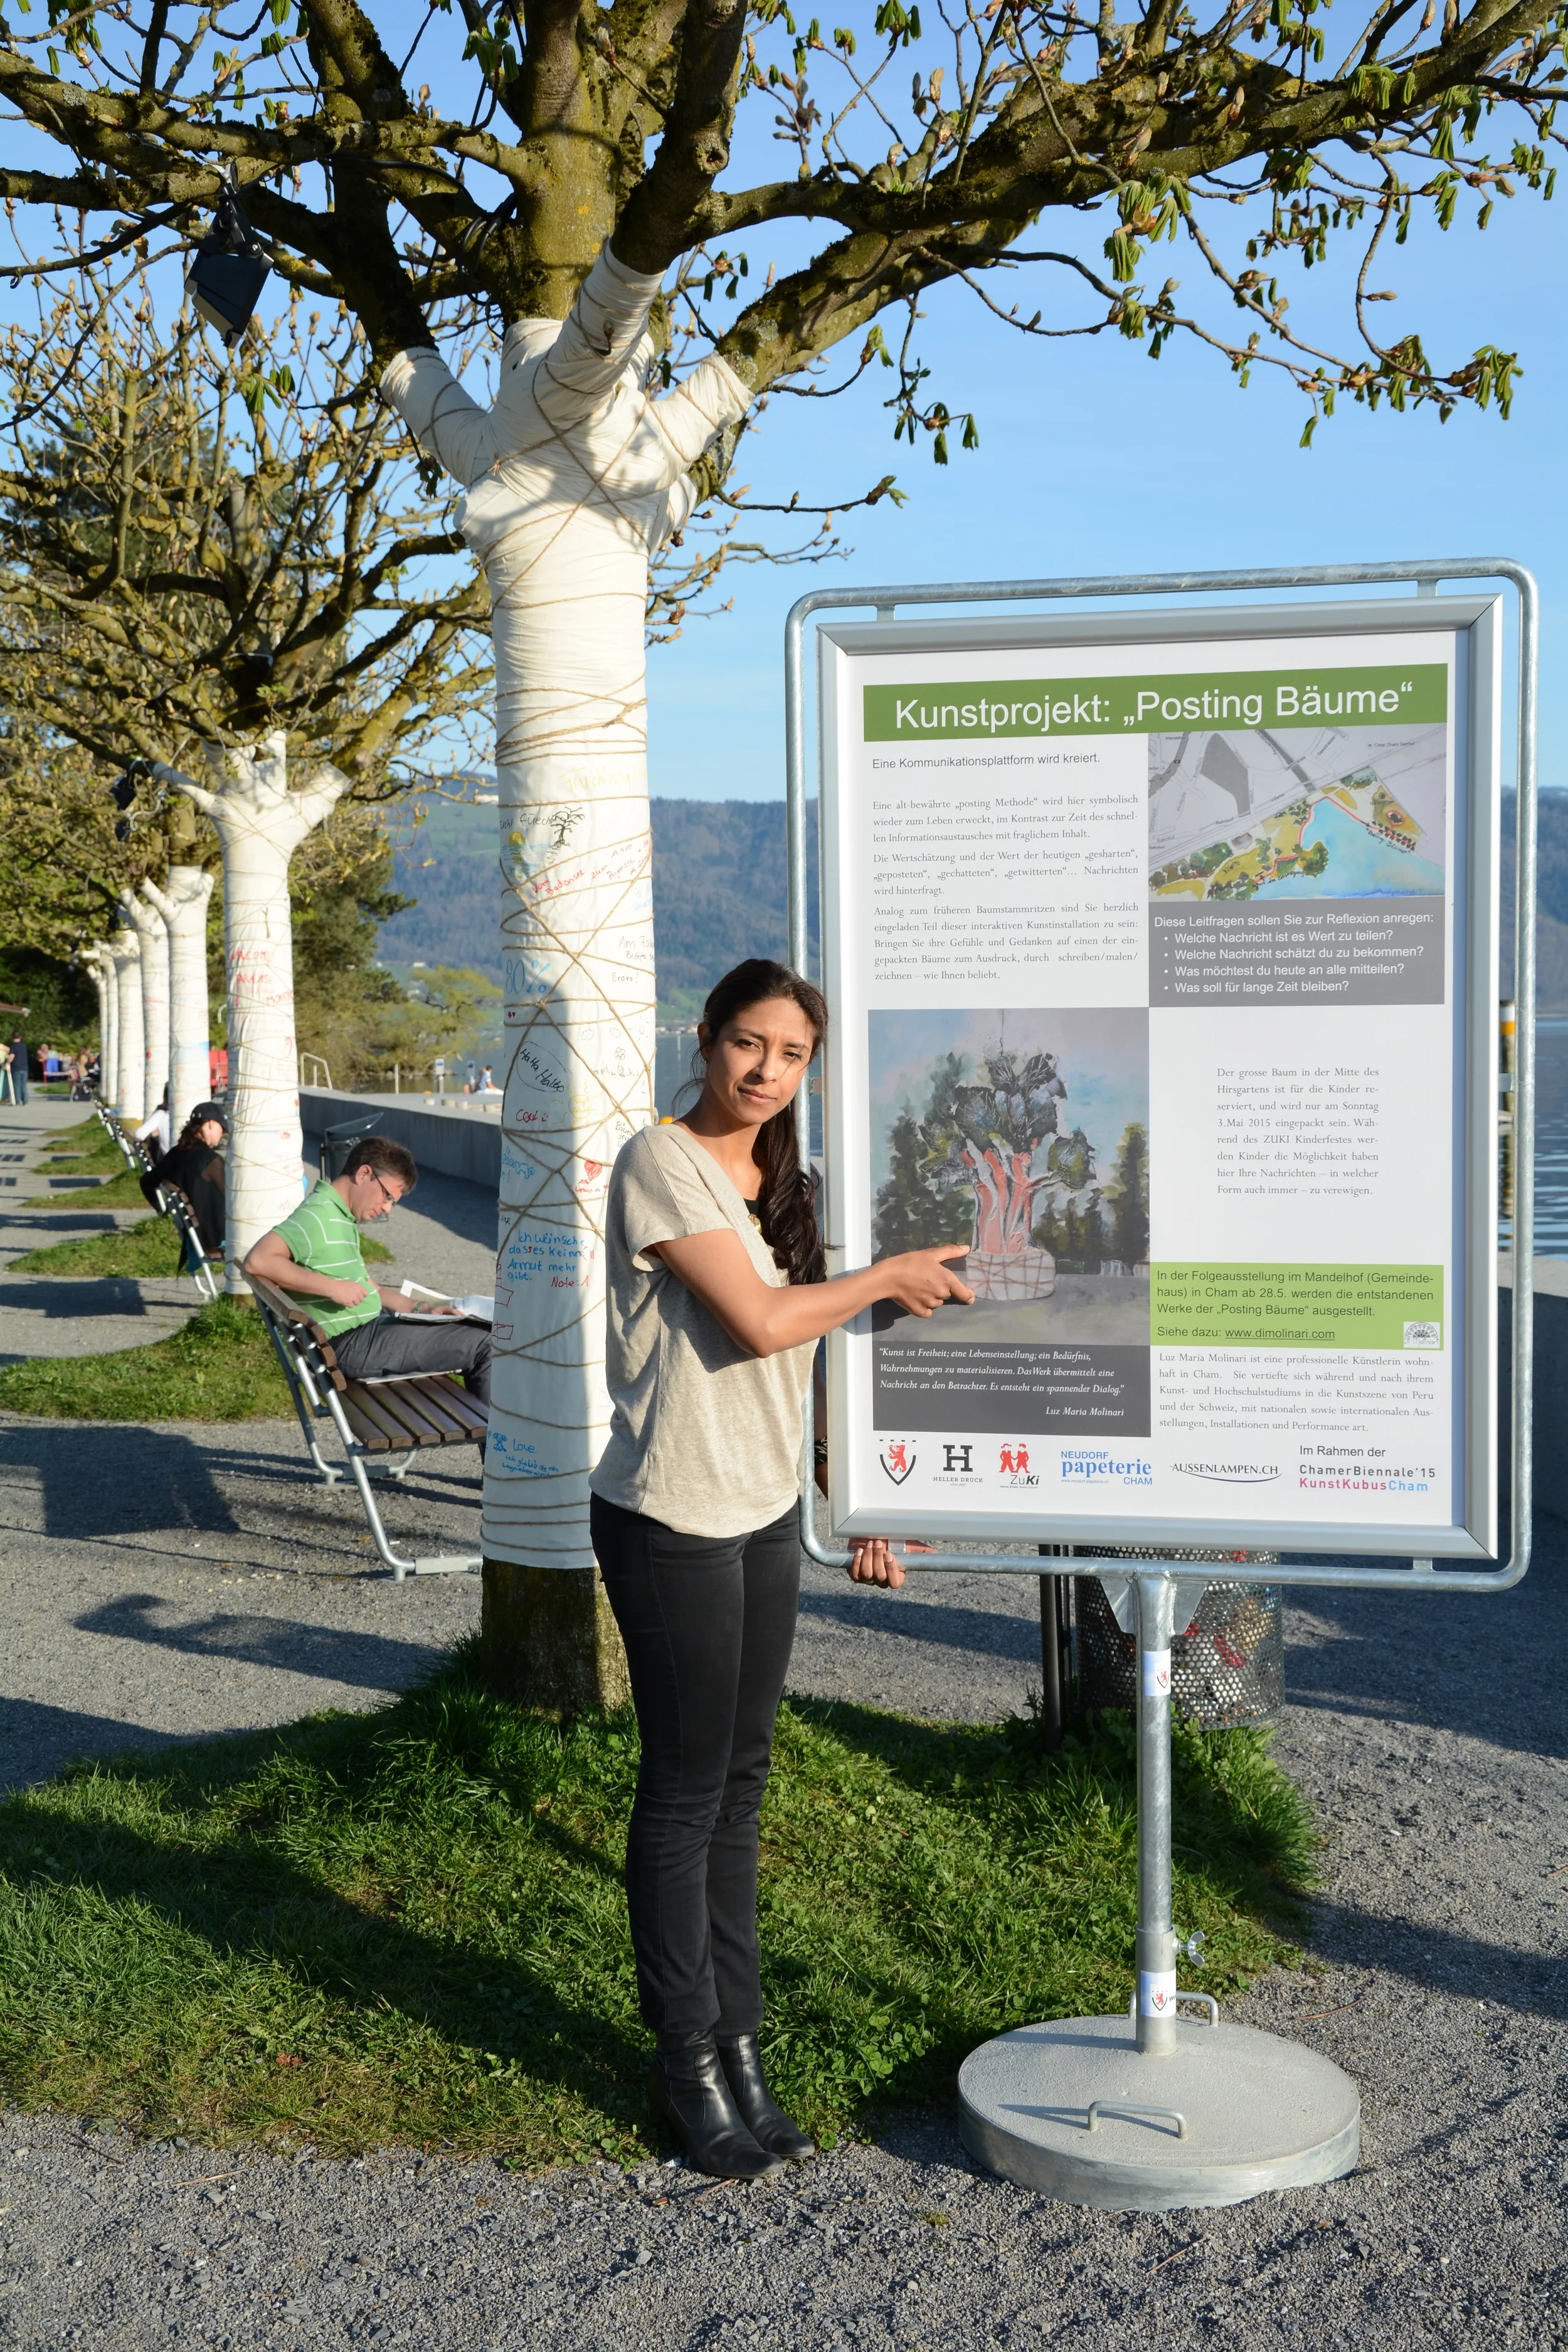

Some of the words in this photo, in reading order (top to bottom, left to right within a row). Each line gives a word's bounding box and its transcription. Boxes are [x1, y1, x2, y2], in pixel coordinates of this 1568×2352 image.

[896, 694, 1110, 733] Kunstprojekt:
[872, 758, 896, 769] Eine
[899, 755, 1034, 768] Kommunikationsplattform
[1037, 753, 1059, 764] wird
[1063, 753, 1100, 763] kreiert.
[873, 801, 892, 810] Eine
[896, 799, 951, 809] alt-bewährte
[1042, 796, 1063, 805] wird
[1067, 795, 1085, 805] hier
[1089, 794, 1138, 808] symbolisch
[873, 817, 903, 826] wieder
[927, 815, 953, 825] Leben
[955, 814, 994, 825] erweckt,
[997, 815, 1008, 824] im
[1011, 814, 1049, 823] Kontrast
[1068, 813, 1087, 822] Zeit
[1089, 812, 1104, 821] des
[1106, 810, 1138, 820] schnel-
[873, 833, 886, 842] len
[889, 830, 993, 842] Informationsaustausches
[995, 831, 1011, 840] mit
[1013, 829, 1059, 842] fraglichem
[1062, 829, 1090, 838] Inhalt.
[1154, 916, 1186, 927] Diese
[1189, 916, 1244, 929] Leitfragen
[1247, 914, 1280, 926] sollen
[1283, 914, 1303, 925] Sie
[1305, 916, 1324, 924] zur
[1327, 913, 1380, 924] Reflexion
[1382, 914, 1434, 925] anregen:
[1174, 933, 1216, 943] Welche
[1219, 931, 1273, 943] Nachricht
[1275, 931, 1289, 942] ist
[1291, 933, 1305, 942] es
[1308, 931, 1336, 941] Wert
[1338, 933, 1352, 941] zu
[1355, 930, 1394, 941] teilen?
[1174, 949, 1217, 960] Welche
[1219, 948, 1273, 960] Nachricht
[1275, 948, 1316, 959] schätzt
[1318, 947, 1333, 958] du
[1336, 949, 1350, 958] zu
[1353, 945, 1424, 958] bekommen?
[1175, 966, 1200, 977] Was
[1203, 965, 1254, 976] möchtest
[1256, 965, 1271, 976] du
[1274, 965, 1306, 975] heute
[1308, 967, 1323, 975] an
[1326, 964, 1347, 975] alle
[1349, 963, 1405, 974] mitteilen?
[1174, 982, 1200, 993] Was
[1202, 982, 1222, 993] soll
[1224, 982, 1241, 992] für
[1243, 982, 1274, 995] lange
[1276, 981, 1299, 992] Zeit
[1301, 980, 1349, 992] bleiben?
[1218, 1118, 1243, 1127] 3.Mai
[1248, 1118, 1271, 1127] 2015
[1275, 1118, 1325, 1131] eingepackt
[1328, 1118, 1350, 1127] sein.
[1353, 1118, 1379, 1127] Wäh-
[549, 1263, 576, 1272] mehr
[1157, 1270, 1167, 1280] In
[1170, 1270, 1189, 1280] der
[1192, 1270, 1285, 1284] Folgeausstellung
[1288, 1271, 1301, 1281] im
[1305, 1271, 1364, 1283] Mandelhof
[1367, 1272, 1434, 1285] (Gemeinde-
[1157, 1286, 1187, 1299] haus)
[1192, 1287, 1201, 1297] in
[1205, 1287, 1237, 1298] Cham
[1242, 1288, 1256, 1298] ab
[1259, 1288, 1287, 1298] 28.5.
[1291, 1288, 1332, 1299] werden
[1336, 1289, 1353, 1299] die
[1357, 1290, 1434, 1300] entstandenen
[1157, 1303, 1192, 1313] Werke
[1195, 1303, 1214, 1314] der
[1312, 1306, 1375, 1318] ausgestellt.
[1157, 1326, 1189, 1337] Siehe
[1192, 1327, 1221, 1337] dazu:
[1224, 1328, 1336, 1341] www.dimolinari.com
[906, 1348, 916, 1357] ist
[918, 1348, 950, 1359] Freiheit;
[968, 1348, 1037, 1362] Lebenseinstellung;
[1052, 1350, 1091, 1363] Bedürfnis,
[1159, 1352, 1175, 1361] Luz
[1179, 1353, 1205, 1362] Maria
[1208, 1353, 1246, 1362] Molinari
[1250, 1354, 1261, 1363] ist
[1264, 1355, 1283, 1364] eine
[1286, 1354, 1349, 1367] professionelle
[1352, 1356, 1401, 1365] Künstlerin
[1404, 1357, 1434, 1366] wohn-
[881, 1364, 943, 1376] Wahrnehmungen
[956, 1365, 1015, 1375] materialisieren.
[1053, 1367, 1096, 1377] übermittelt
[880, 1379, 918, 1389] Nachricht
[931, 1380, 946, 1389] den
[948, 1380, 988, 1391] Betrachter.
[990, 1382, 999, 1391] Es
[1000, 1382, 1030, 1392] entsteht
[1046, 1384, 1091, 1395] spannender
[1046, 1406, 1061, 1415] Luz
[1062, 1407, 1087, 1416] Maria
[1089, 1407, 1124, 1416] Molinari
[513, 1439, 538, 1453] Love
[1300, 1444, 1313, 1455] Im
[1317, 1445, 1364, 1457] Rahmen
[1367, 1447, 1386, 1457] der
[1061, 1451, 1109, 1459] NEUDORF
[1061, 1459, 1152, 1478] papeterie
[1171, 1462, 1278, 1475] AUSSENLAMPEN.CH
[1010, 1475, 1040, 1485] ZuKi
[1123, 1476, 1153, 1485] CHAM
